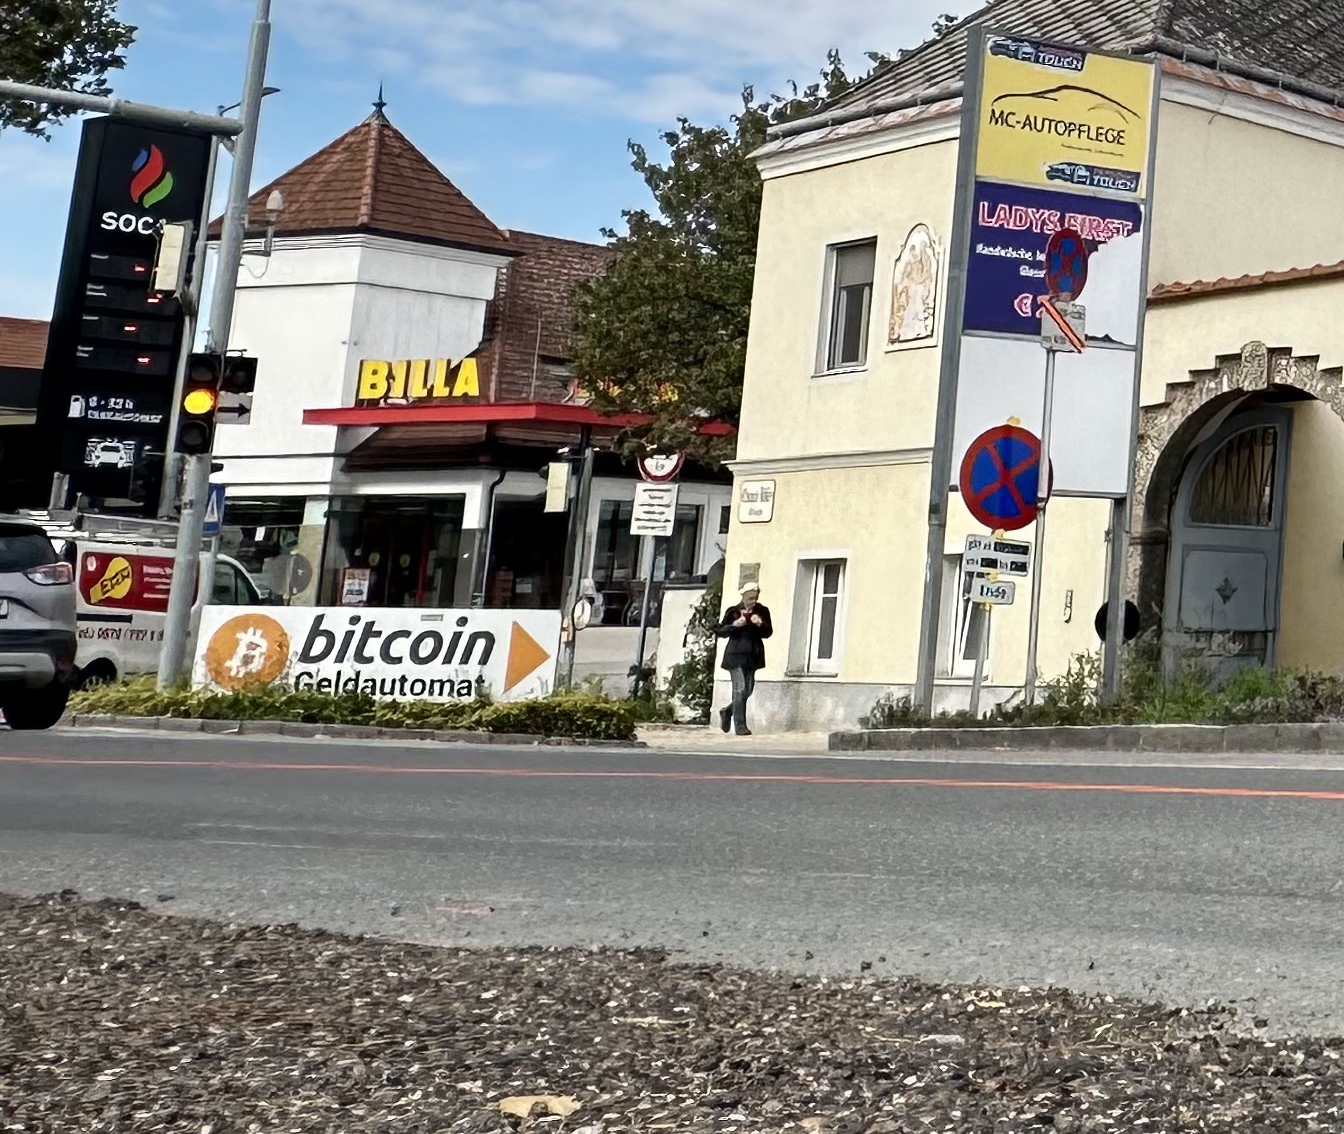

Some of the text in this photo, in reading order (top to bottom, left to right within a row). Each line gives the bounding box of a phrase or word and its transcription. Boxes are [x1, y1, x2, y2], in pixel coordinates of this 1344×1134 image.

[988, 109, 1126, 145] MC-AUTOPFLEGE
[978, 201, 1061, 234] LADYS
[358, 357, 480, 400] BILLA
[298, 613, 496, 666] bitcoin
[293, 670, 486, 698] Geldautomat
